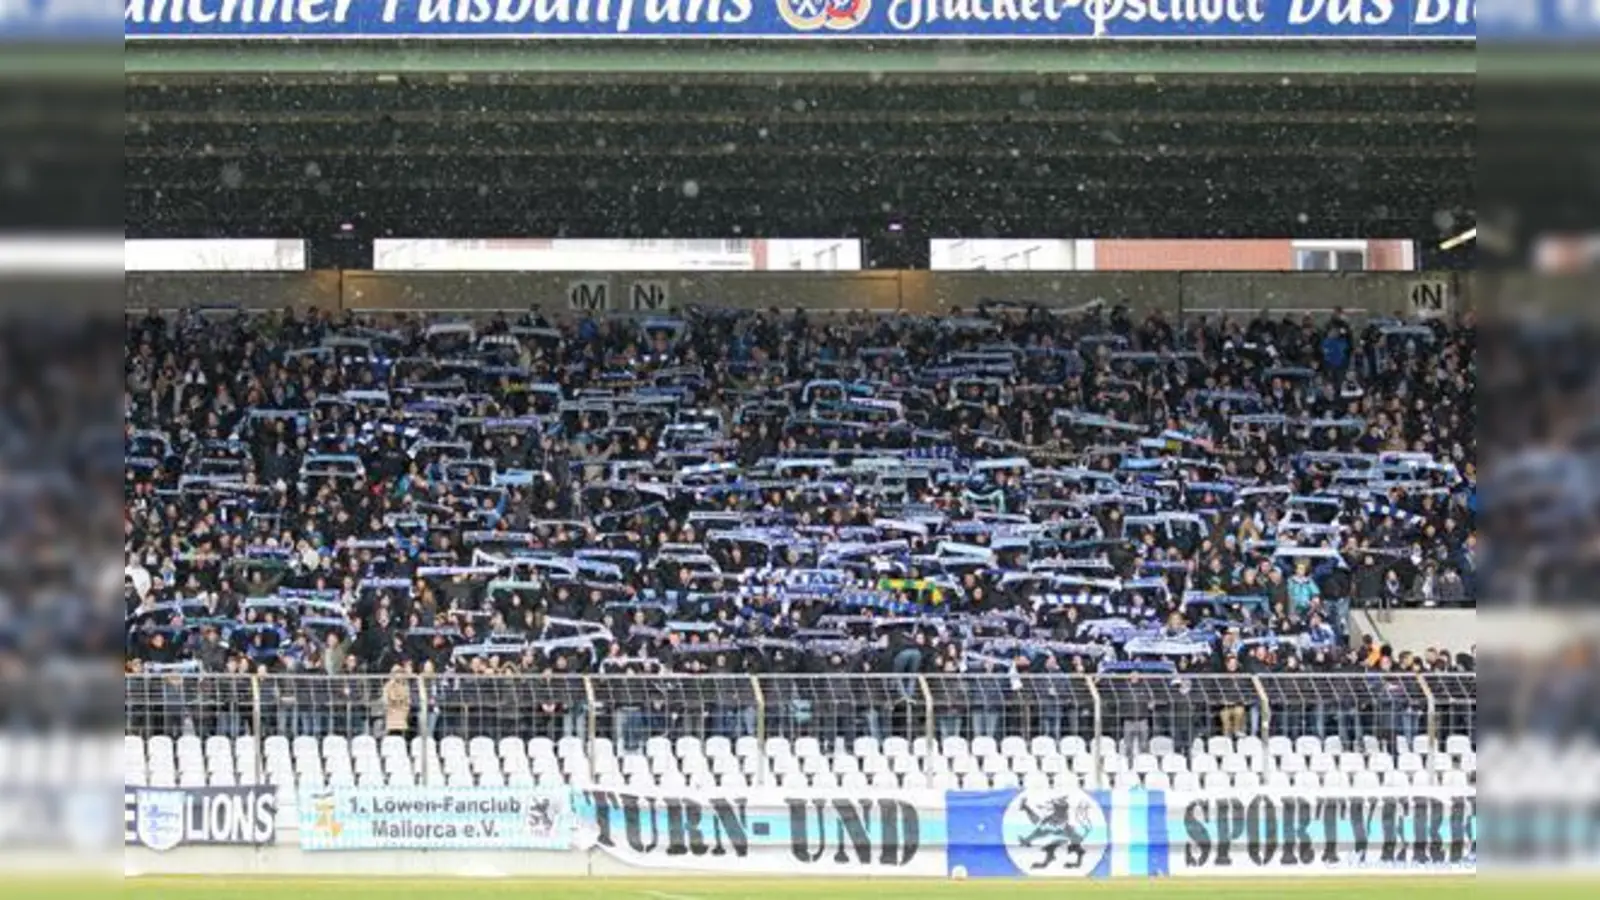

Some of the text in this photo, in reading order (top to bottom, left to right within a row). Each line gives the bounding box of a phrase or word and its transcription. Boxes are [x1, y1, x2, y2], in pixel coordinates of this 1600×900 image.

[580, 284, 606, 309] M
[633, 284, 656, 309] N
[1421, 283, 1442, 309] N
[186, 790, 277, 843] LIONS
[348, 796, 522, 814] 1. Löwen-Fanclub
[371, 820, 499, 838] Mallorca e.V.
[582, 789, 920, 867] TURN- UND
